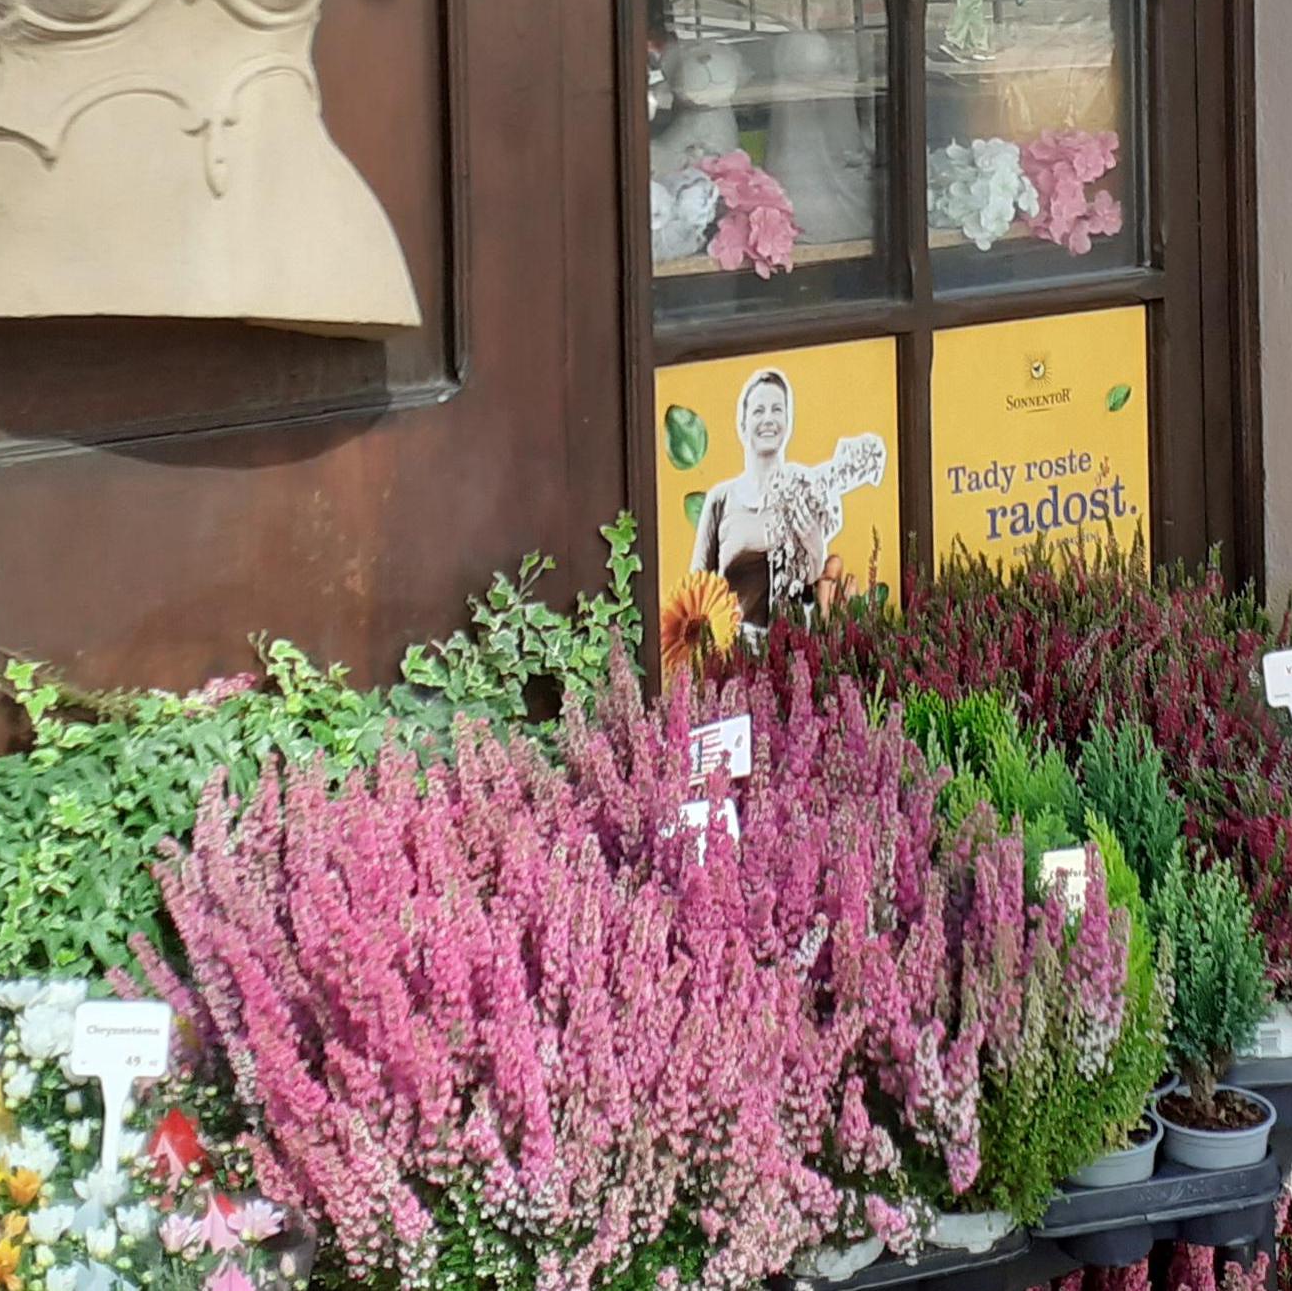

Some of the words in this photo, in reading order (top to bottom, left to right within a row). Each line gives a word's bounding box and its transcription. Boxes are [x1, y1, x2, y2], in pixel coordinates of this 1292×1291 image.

[948, 460, 1016, 494] Tady
[1024, 449, 1092, 481] roste
[986, 475, 1137, 540] radost.
